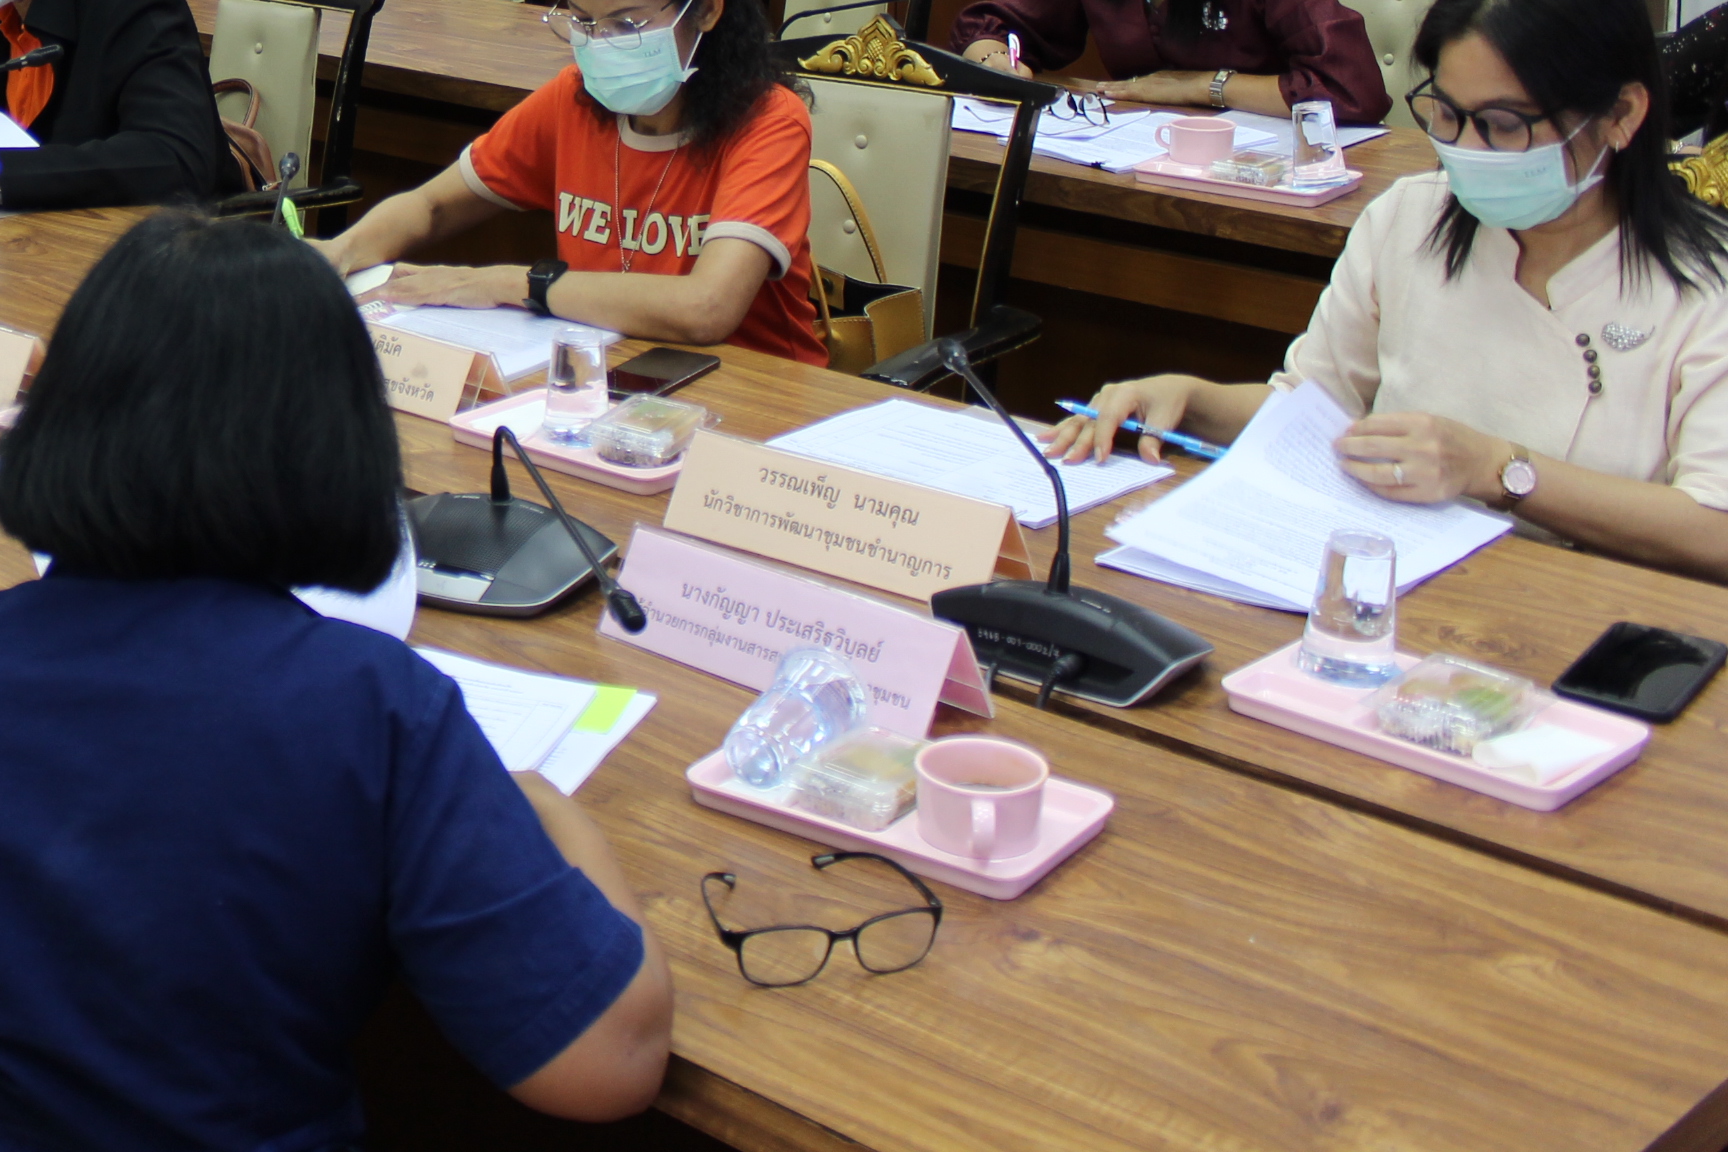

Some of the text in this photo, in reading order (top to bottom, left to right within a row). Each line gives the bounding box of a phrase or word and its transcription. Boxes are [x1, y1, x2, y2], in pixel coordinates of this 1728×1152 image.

[558, 191, 711, 258] WE LOVE
[759, 467, 921, 529] วรรณเพ็ญ นามคุณ
[703, 489, 953, 580] นักวิชาการพัฒนาชุมชนชำนาญการ
[681, 582, 760, 626] นางกัญญา
